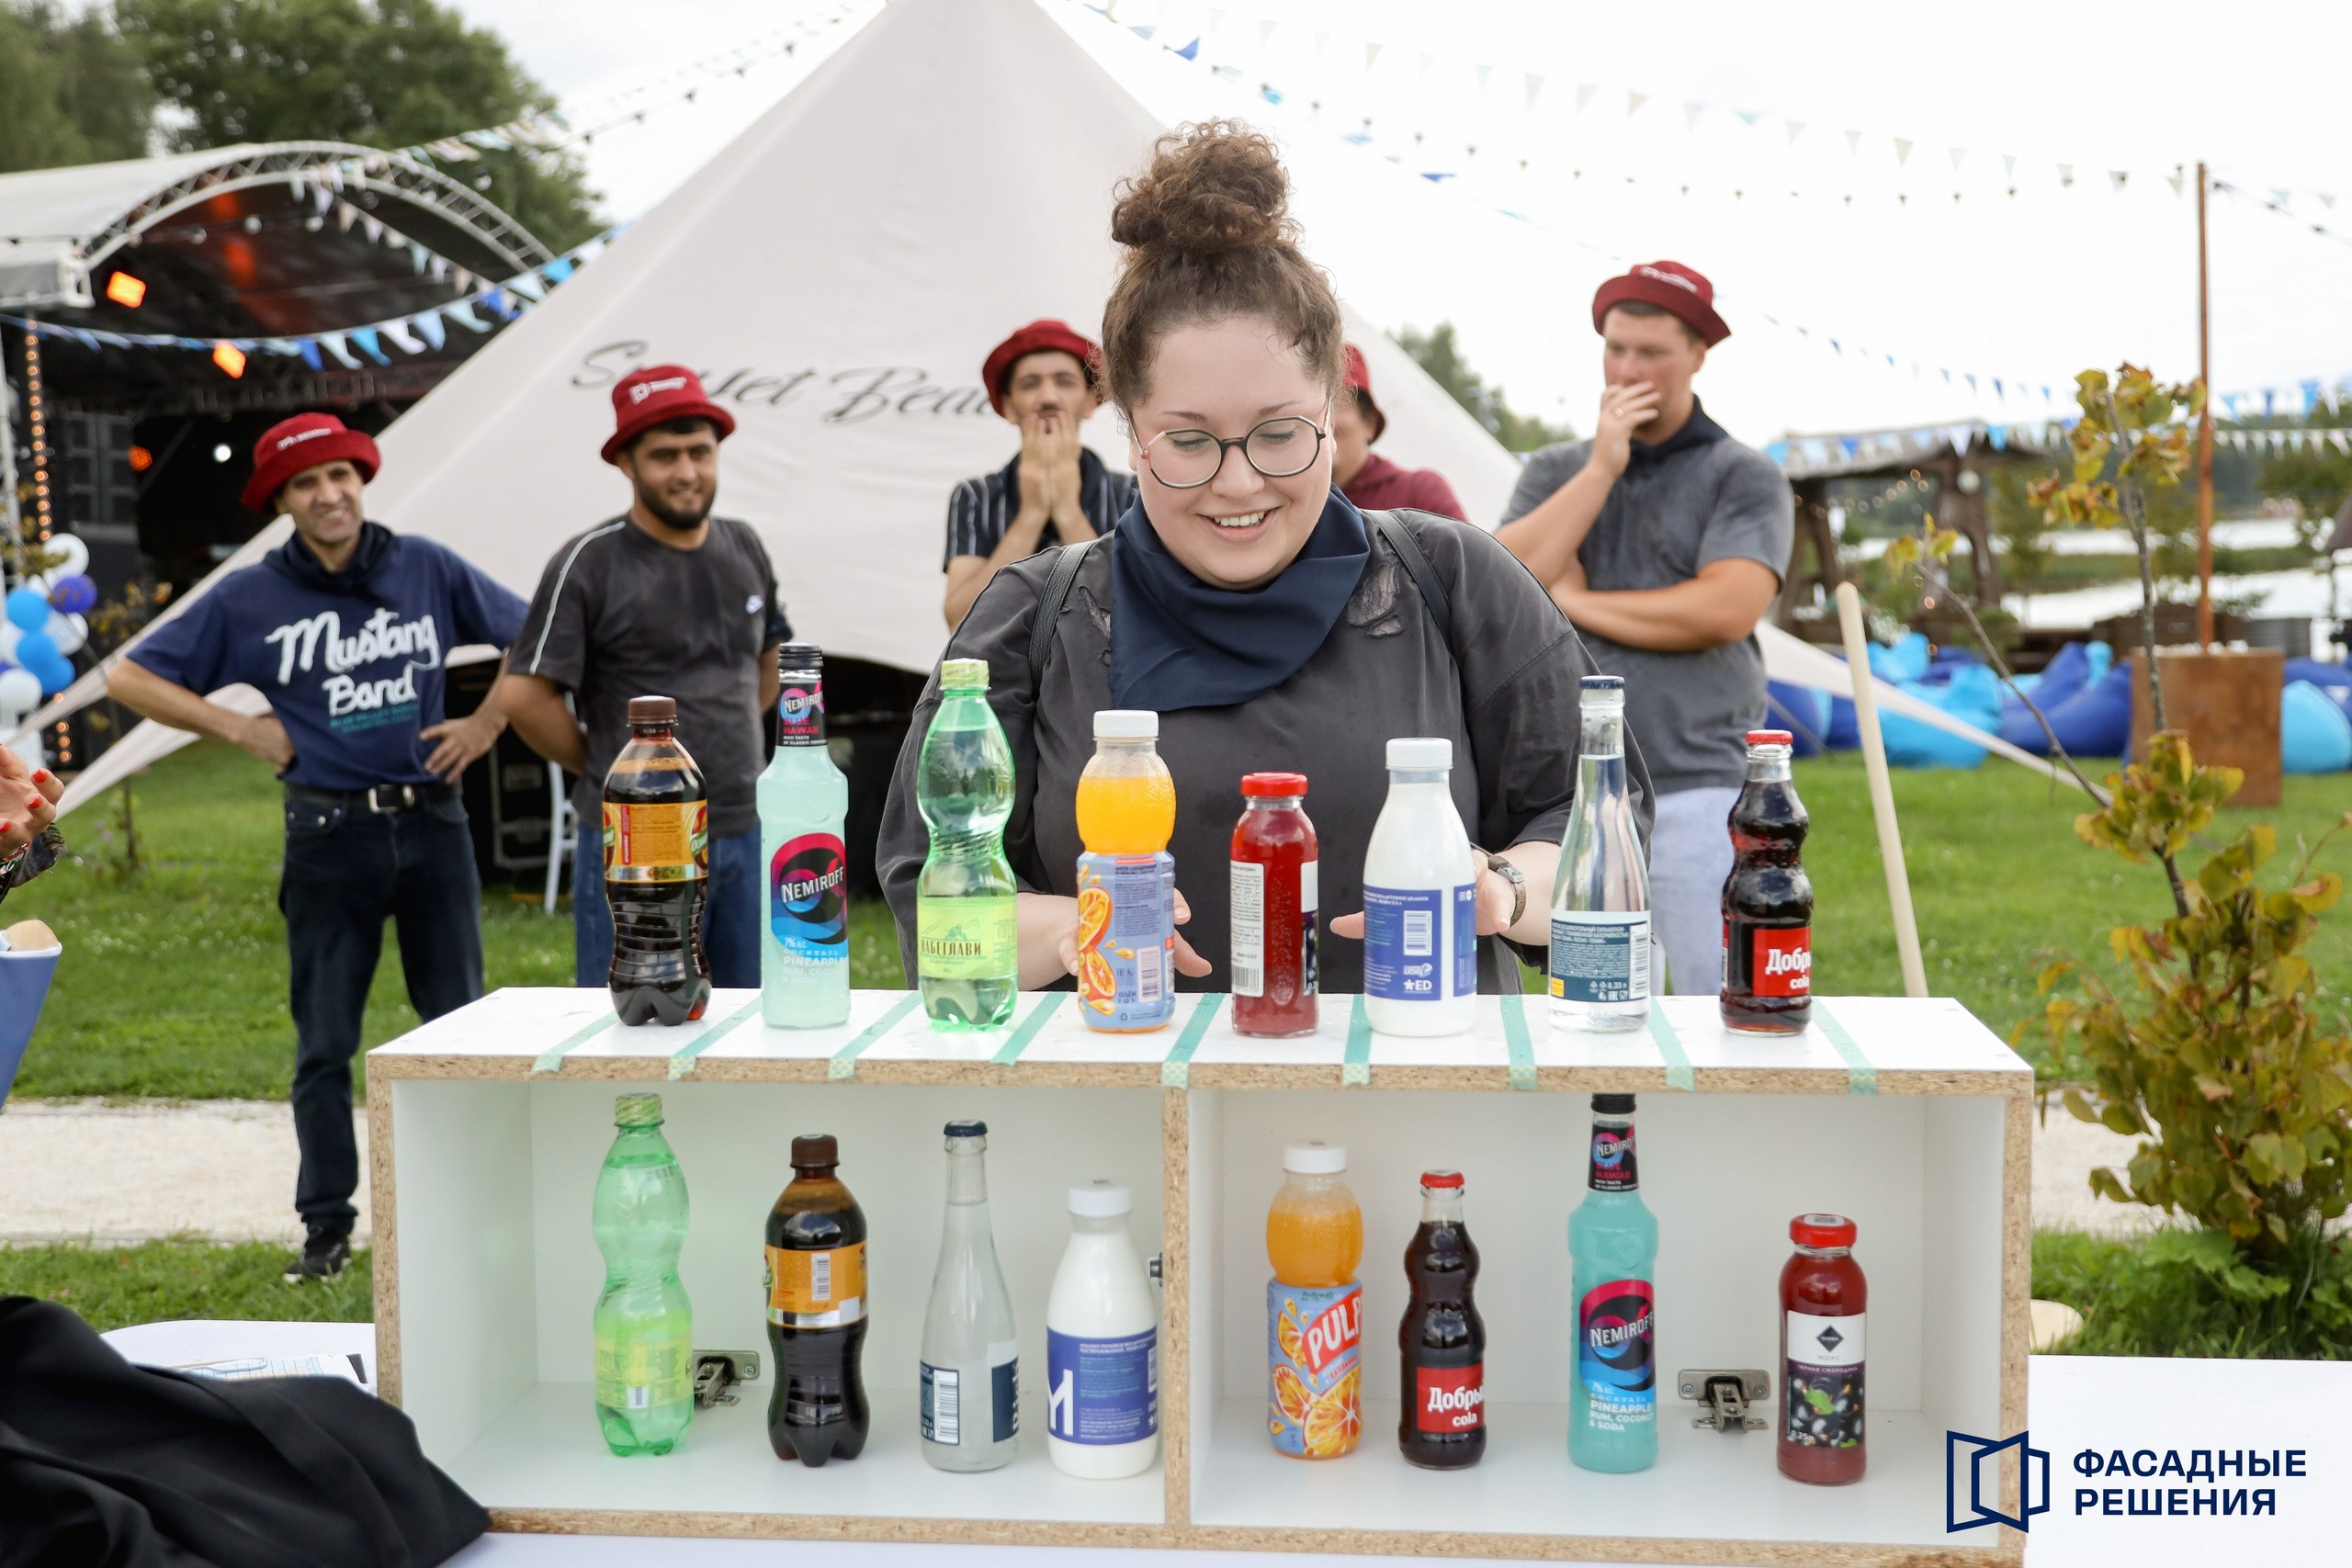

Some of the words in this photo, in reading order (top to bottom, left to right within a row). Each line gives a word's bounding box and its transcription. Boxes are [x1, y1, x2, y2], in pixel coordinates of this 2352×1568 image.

[571, 339, 820, 407] Sset
[824, 367, 992, 426] Beac
[264, 607, 442, 685] Mustang
[322, 663, 418, 716] Band
[784, 691, 824, 714] NEMIROF
[784, 716, 810, 726] BLUE
[783, 726, 820, 735] HAWAII
[781, 866, 844, 904] NEMIROFF
[1790, 975, 1810, 989] cola
[1596, 1161, 1622, 1170] BLUE
[1596, 1170, 1631, 1179] HAWAII
[1301, 1291, 1334, 1302] Добрый
[1308, 1295, 1363, 1370] PULP
[1589, 1311, 1654, 1348] NEMIROFF
[1592, 1382, 1604, 1393] 7%
[1590, 1393, 1646, 1403] COCKTAIL
[1590, 1400, 1652, 1413] PINEAPPLE
[1452, 1411, 1477, 1427] cola
[1589, 1411, 1613, 1422] RUM,
[1598, 1421, 1625, 1431] SODA
